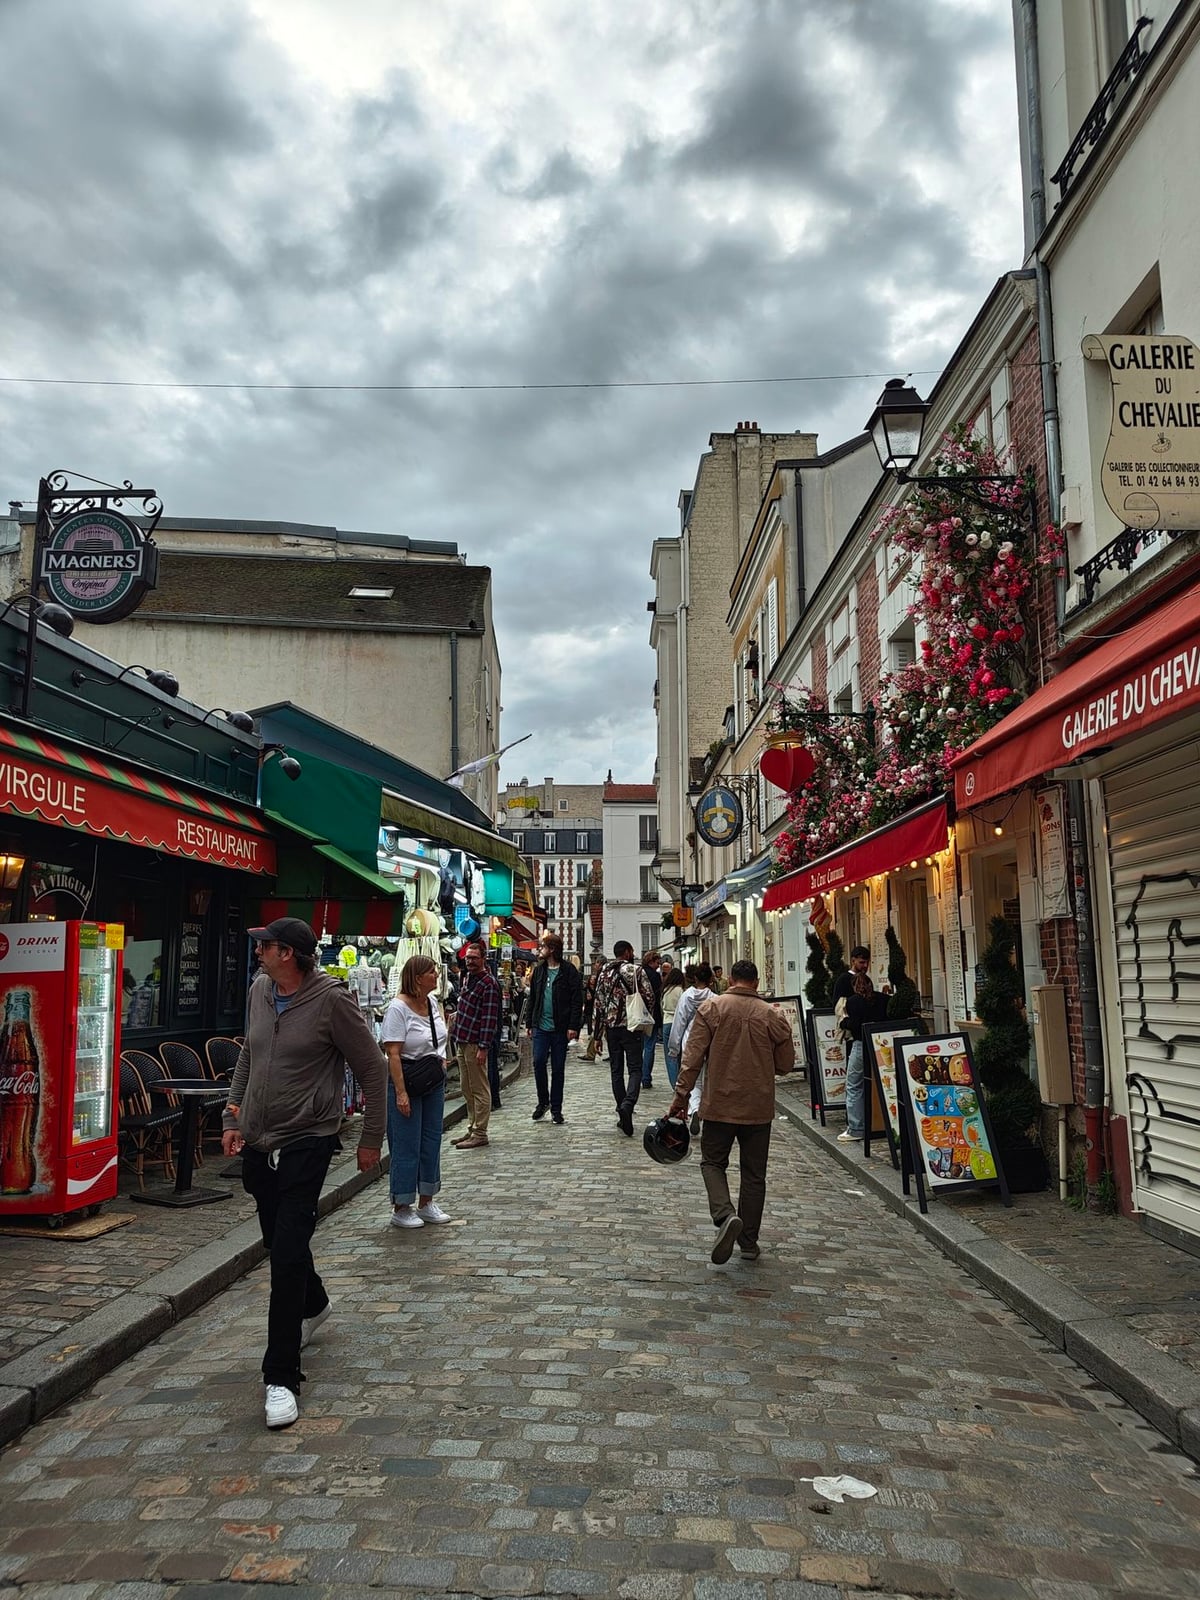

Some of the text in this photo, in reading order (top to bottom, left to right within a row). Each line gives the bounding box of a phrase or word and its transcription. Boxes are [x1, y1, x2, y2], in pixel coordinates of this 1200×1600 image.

[1109, 343, 1195, 370] GALERIE
[1155, 377, 1172, 394] DU
[1118, 401, 1200, 428] CHEVALIE
[1135, 463, 1147, 472] DES
[1148, 462, 1200, 472] COLLECTIONNEUR
[1119, 475, 1200, 487] TEL. 01 42 64 84 93
[47, 554, 137, 569] MAGNERS
[72, 578, 109, 593] Original
[1062, 689, 1119, 749] GALERIE
[1122, 675, 1146, 720] DU
[177, 819, 258, 861] RESTAURANT
[32, 878, 47, 898] LA
[17, 936, 60, 947] DRINK
